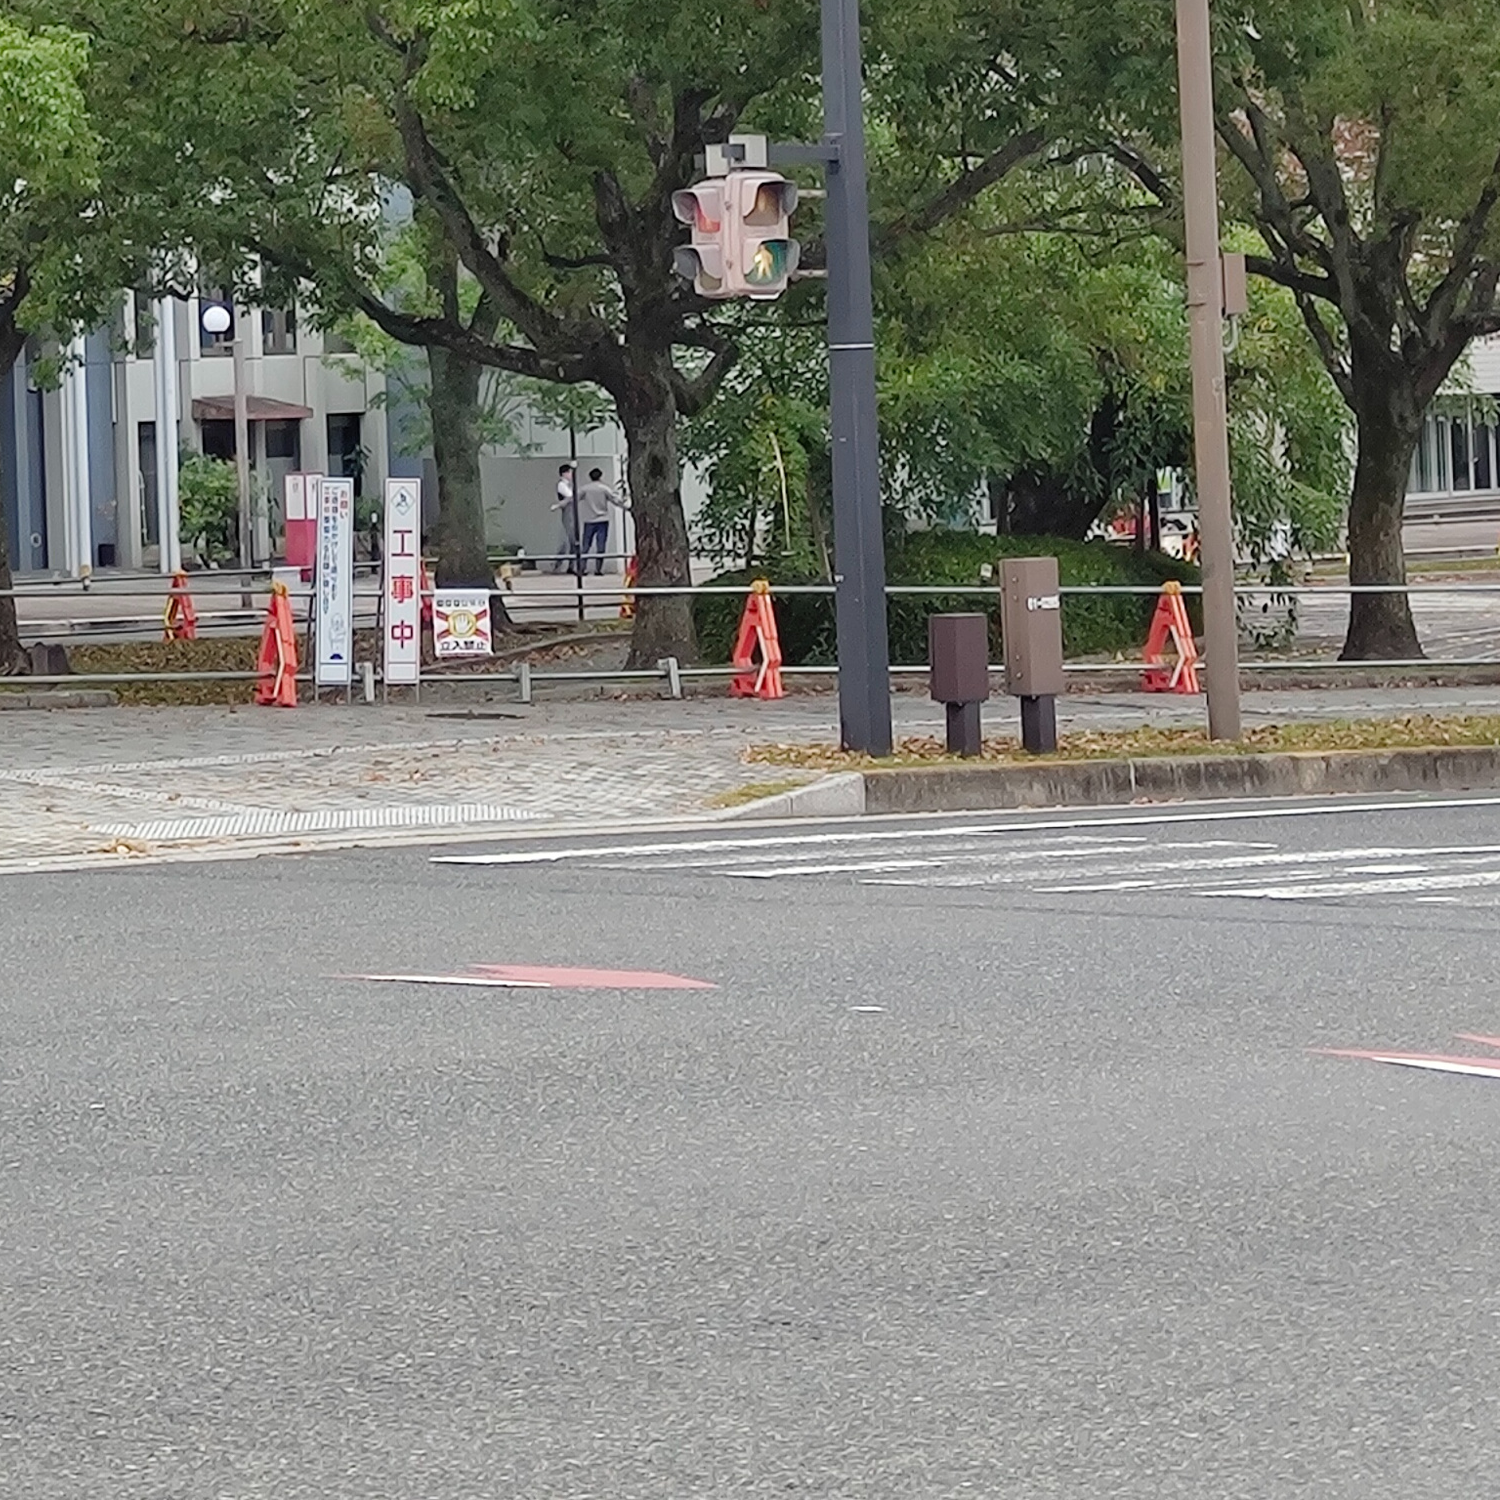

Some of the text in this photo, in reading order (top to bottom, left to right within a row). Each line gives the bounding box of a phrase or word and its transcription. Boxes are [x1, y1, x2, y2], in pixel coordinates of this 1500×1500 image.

[390, 530, 415, 650] 工事中
[440, 640, 486, 652] 立入禁止
